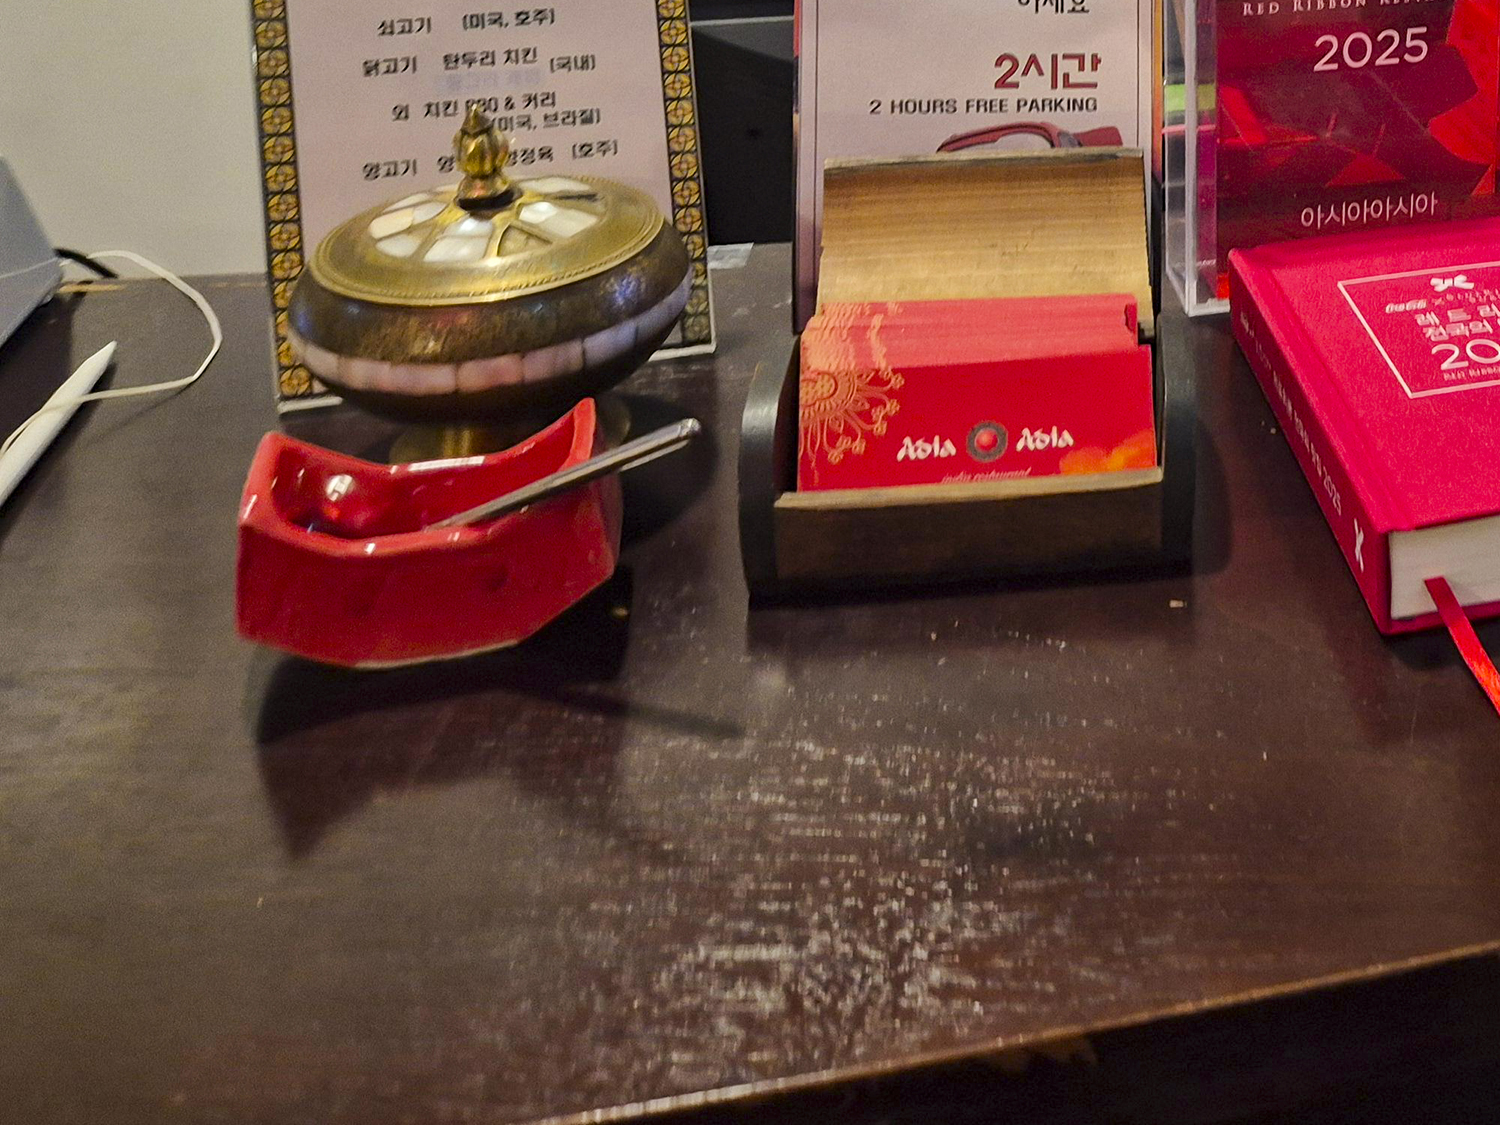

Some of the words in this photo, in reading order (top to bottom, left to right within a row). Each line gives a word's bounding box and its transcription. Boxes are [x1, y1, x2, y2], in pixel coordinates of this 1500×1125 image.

[1243, 1, 1280, 16] RED
[378, 17, 432, 36] 쇠고기
[362, 55, 418, 77] 닭고기
[503, 46, 538, 65] 치킨
[1313, 26, 1428, 72] 2025
[994, 52, 1101, 90] 2시간
[424, 100, 458, 118] 치킨
[522, 91, 557, 109] 커리
[869, 99, 882, 114] 2
[890, 98, 957, 114] HOURS
[965, 98, 1009, 113] FREE
[1016, 97, 1098, 113] PARKING
[362, 158, 418, 181] 양고기
[1300, 191, 1438, 229] 아시아아시아
